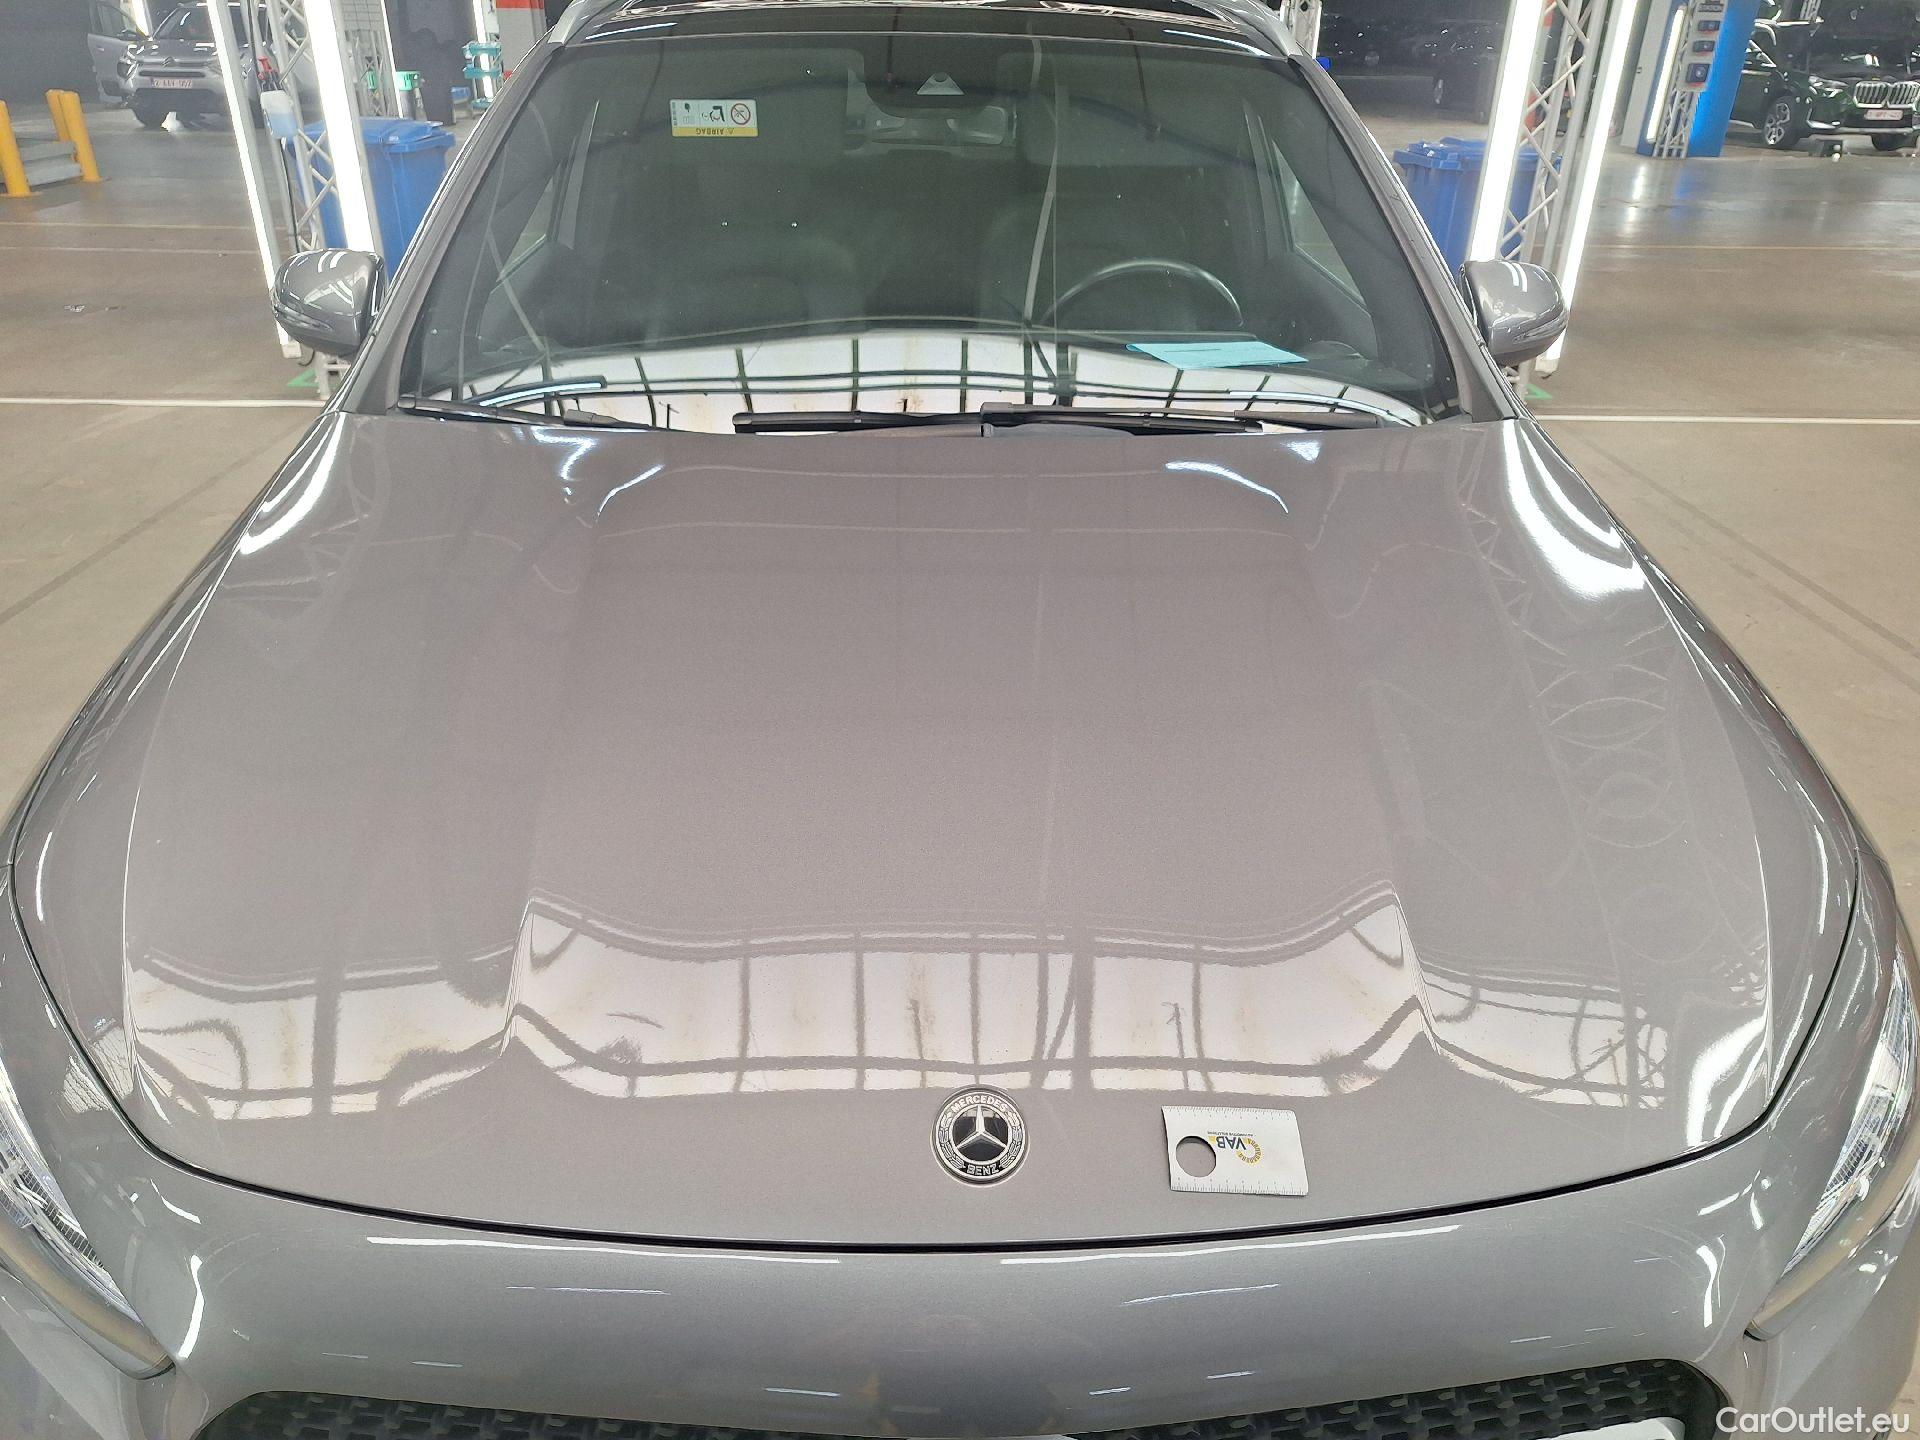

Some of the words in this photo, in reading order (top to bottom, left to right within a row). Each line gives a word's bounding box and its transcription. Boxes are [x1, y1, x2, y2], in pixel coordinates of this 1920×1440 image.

[950, 1095, 1009, 1112] MERCEDES
[1216, 1136, 1247, 1150] VAB
[966, 1163, 1000, 1176] BENZ
